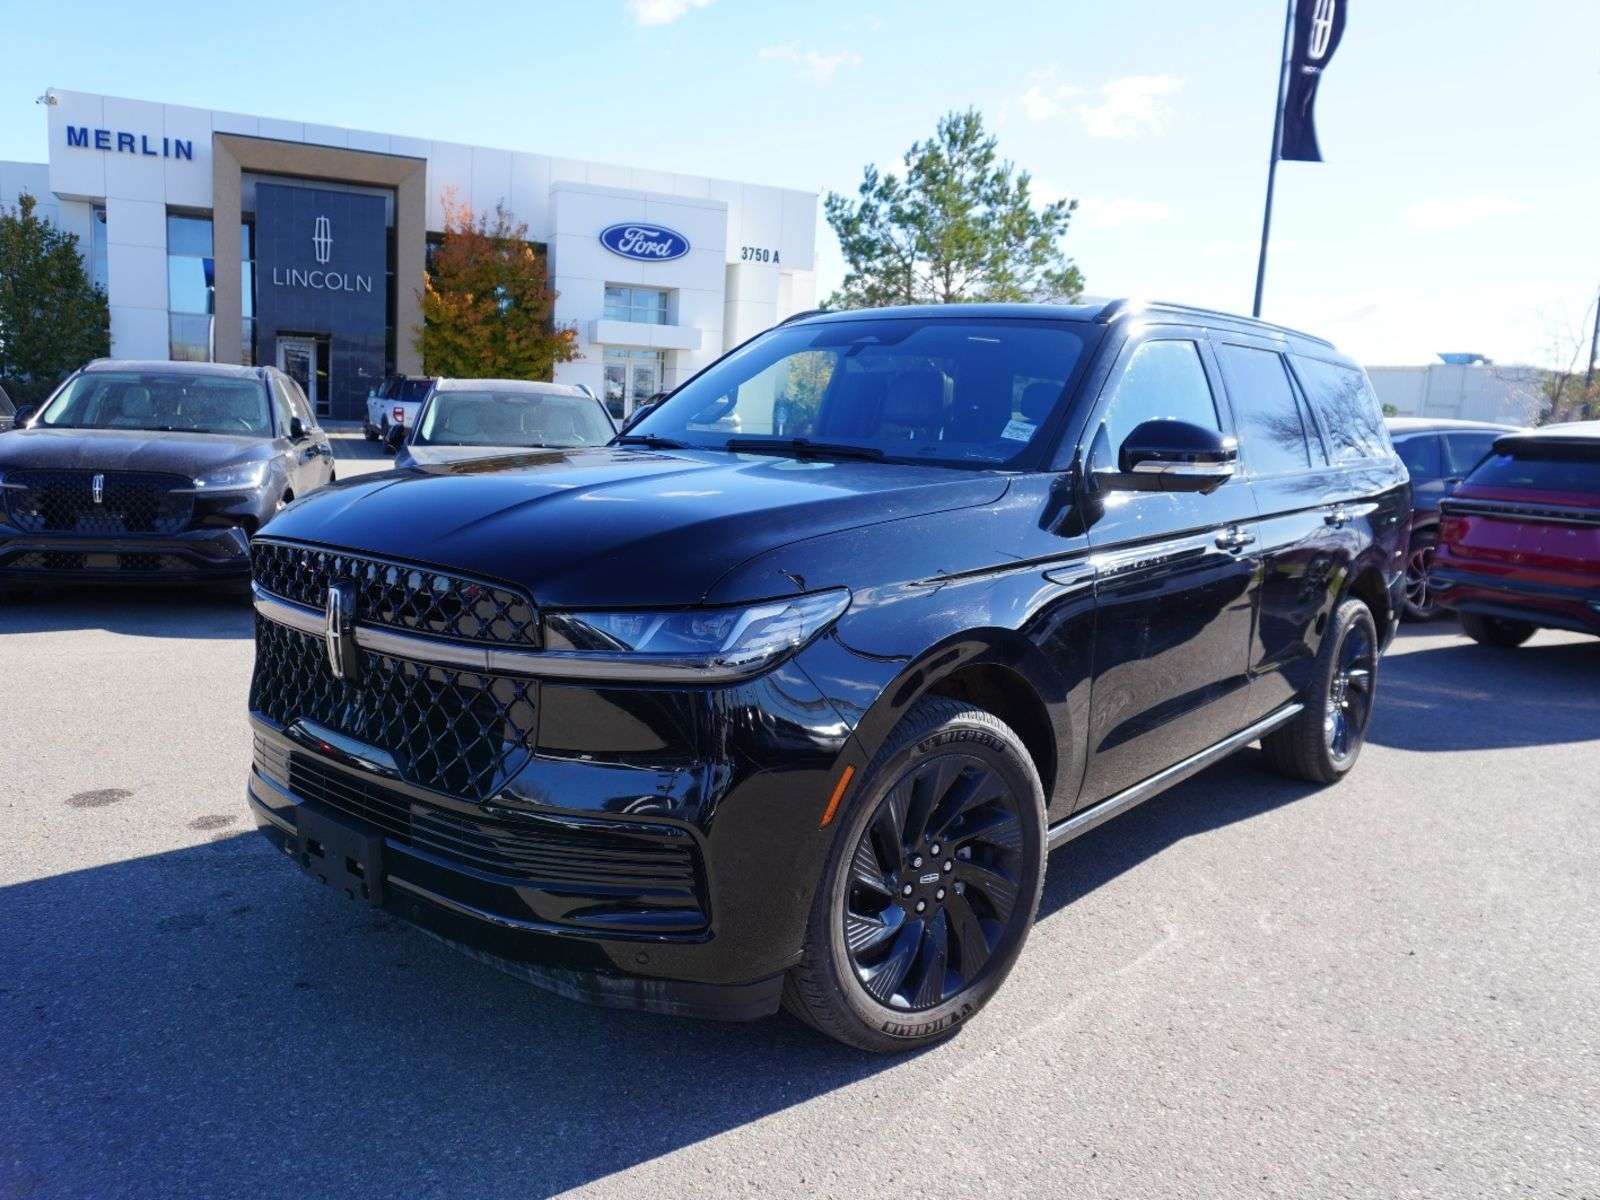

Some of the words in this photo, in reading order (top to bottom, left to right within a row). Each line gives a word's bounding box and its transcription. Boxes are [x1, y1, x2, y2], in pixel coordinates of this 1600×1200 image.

[66, 125, 193, 161] MERLIN
[618, 227, 673, 256] Ford
[741, 246, 769, 263] 3750
[772, 249, 780, 264] A
[273, 267, 372, 292] LINCOLN
[884, 1014, 953, 1036] MICHELIN
